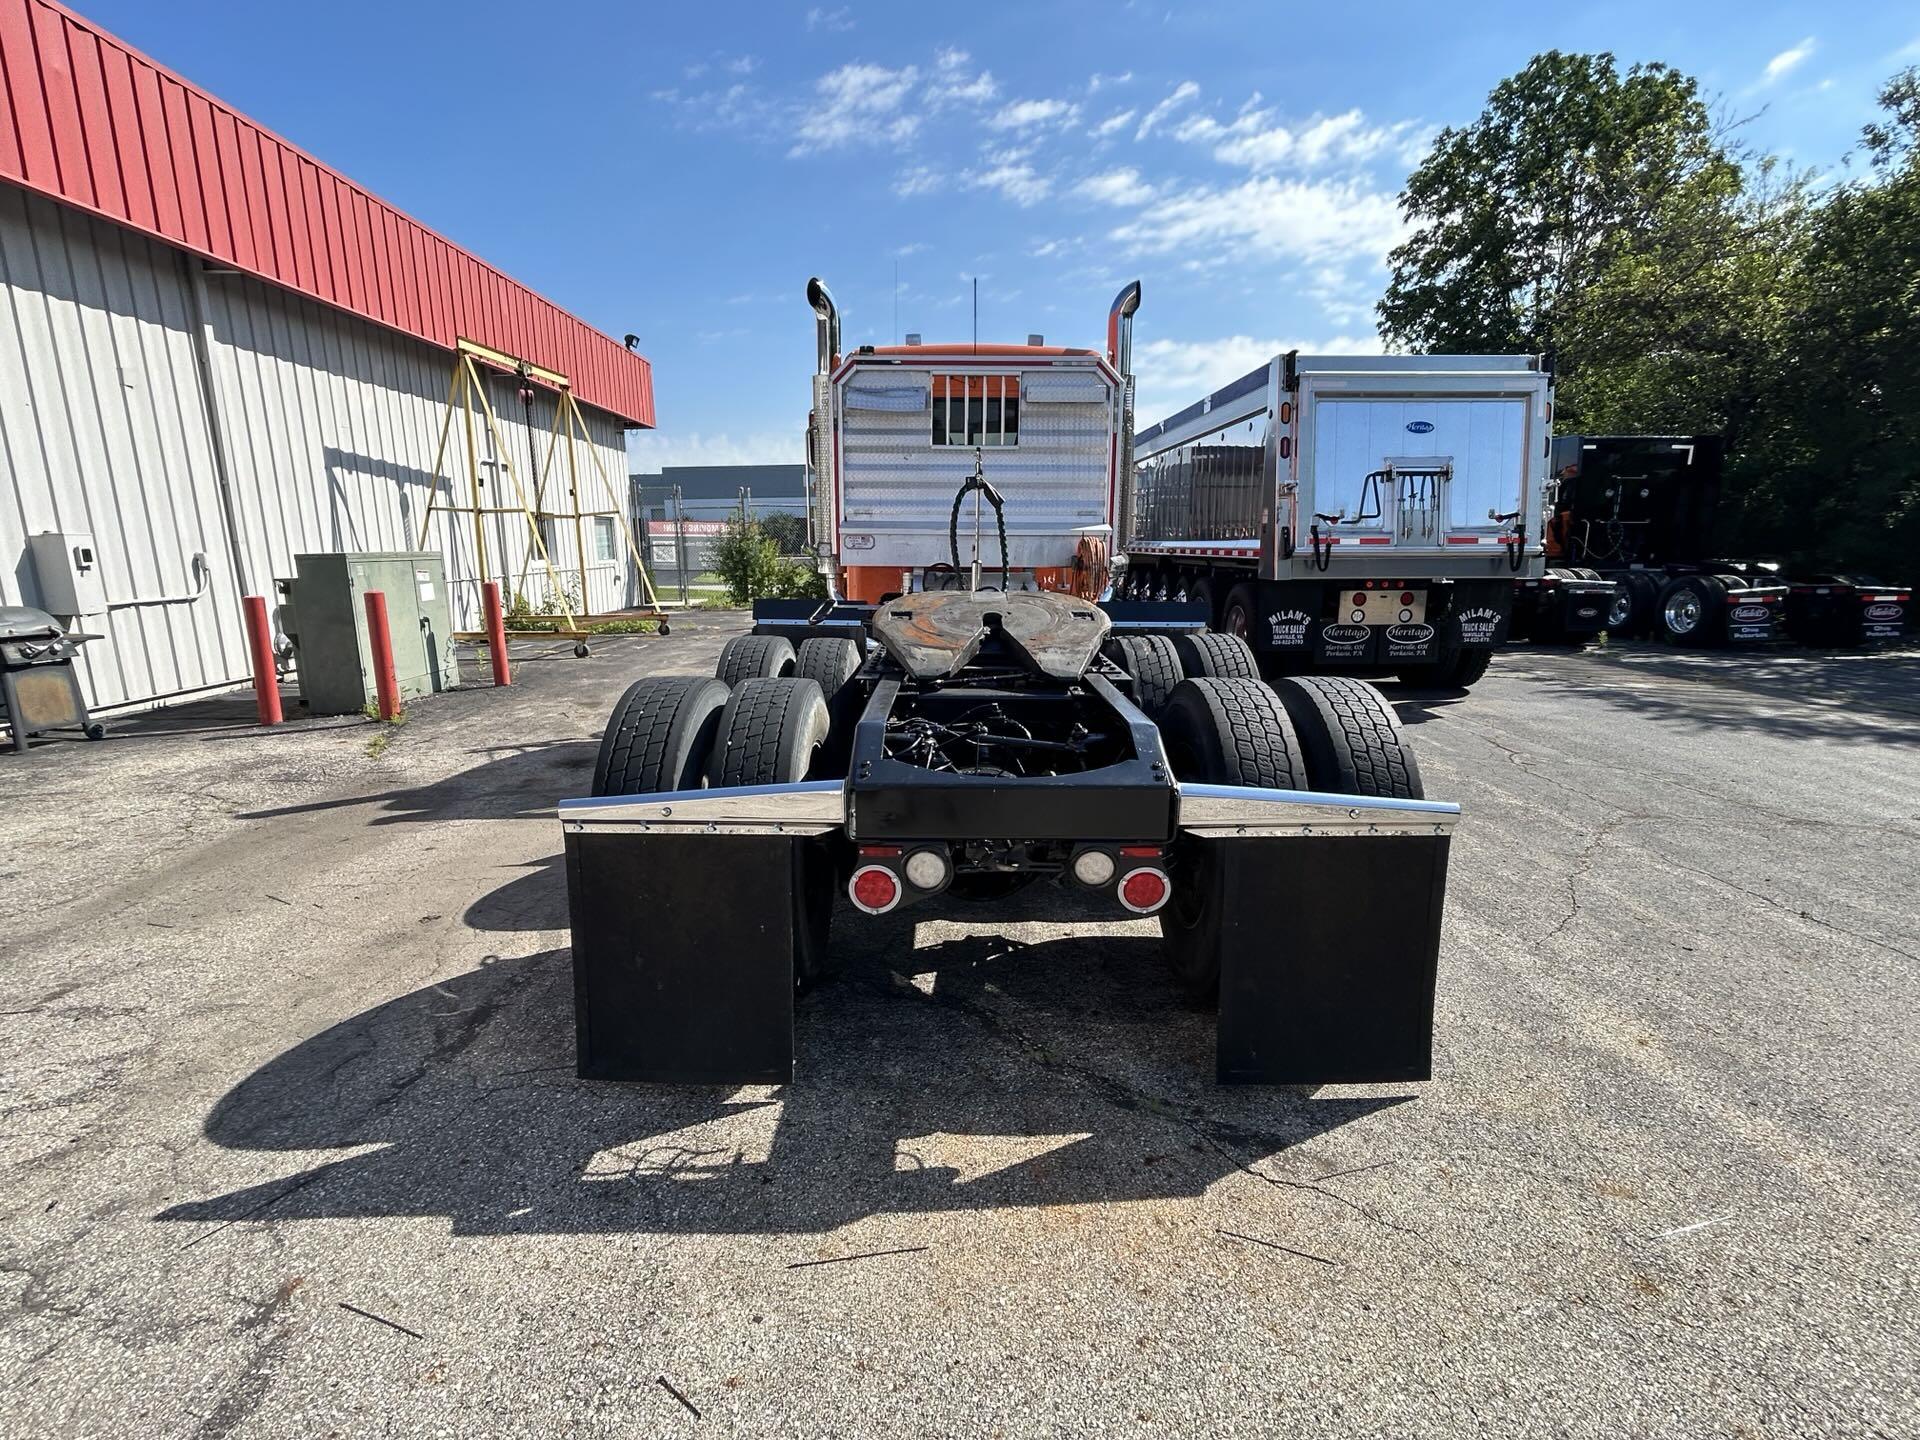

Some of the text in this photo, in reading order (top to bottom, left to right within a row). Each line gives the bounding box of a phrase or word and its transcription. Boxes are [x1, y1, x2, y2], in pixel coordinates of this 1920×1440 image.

[1268, 609, 1311, 625] MILAM'S
[1459, 608, 1501, 623] MILAM'S
[1272, 624, 1306, 634] TRUCK SALES
[1389, 626, 1431, 639] Heritage
[1462, 622, 1495, 631] TRUCK SALES
[1326, 627, 1368, 639] Heritage
